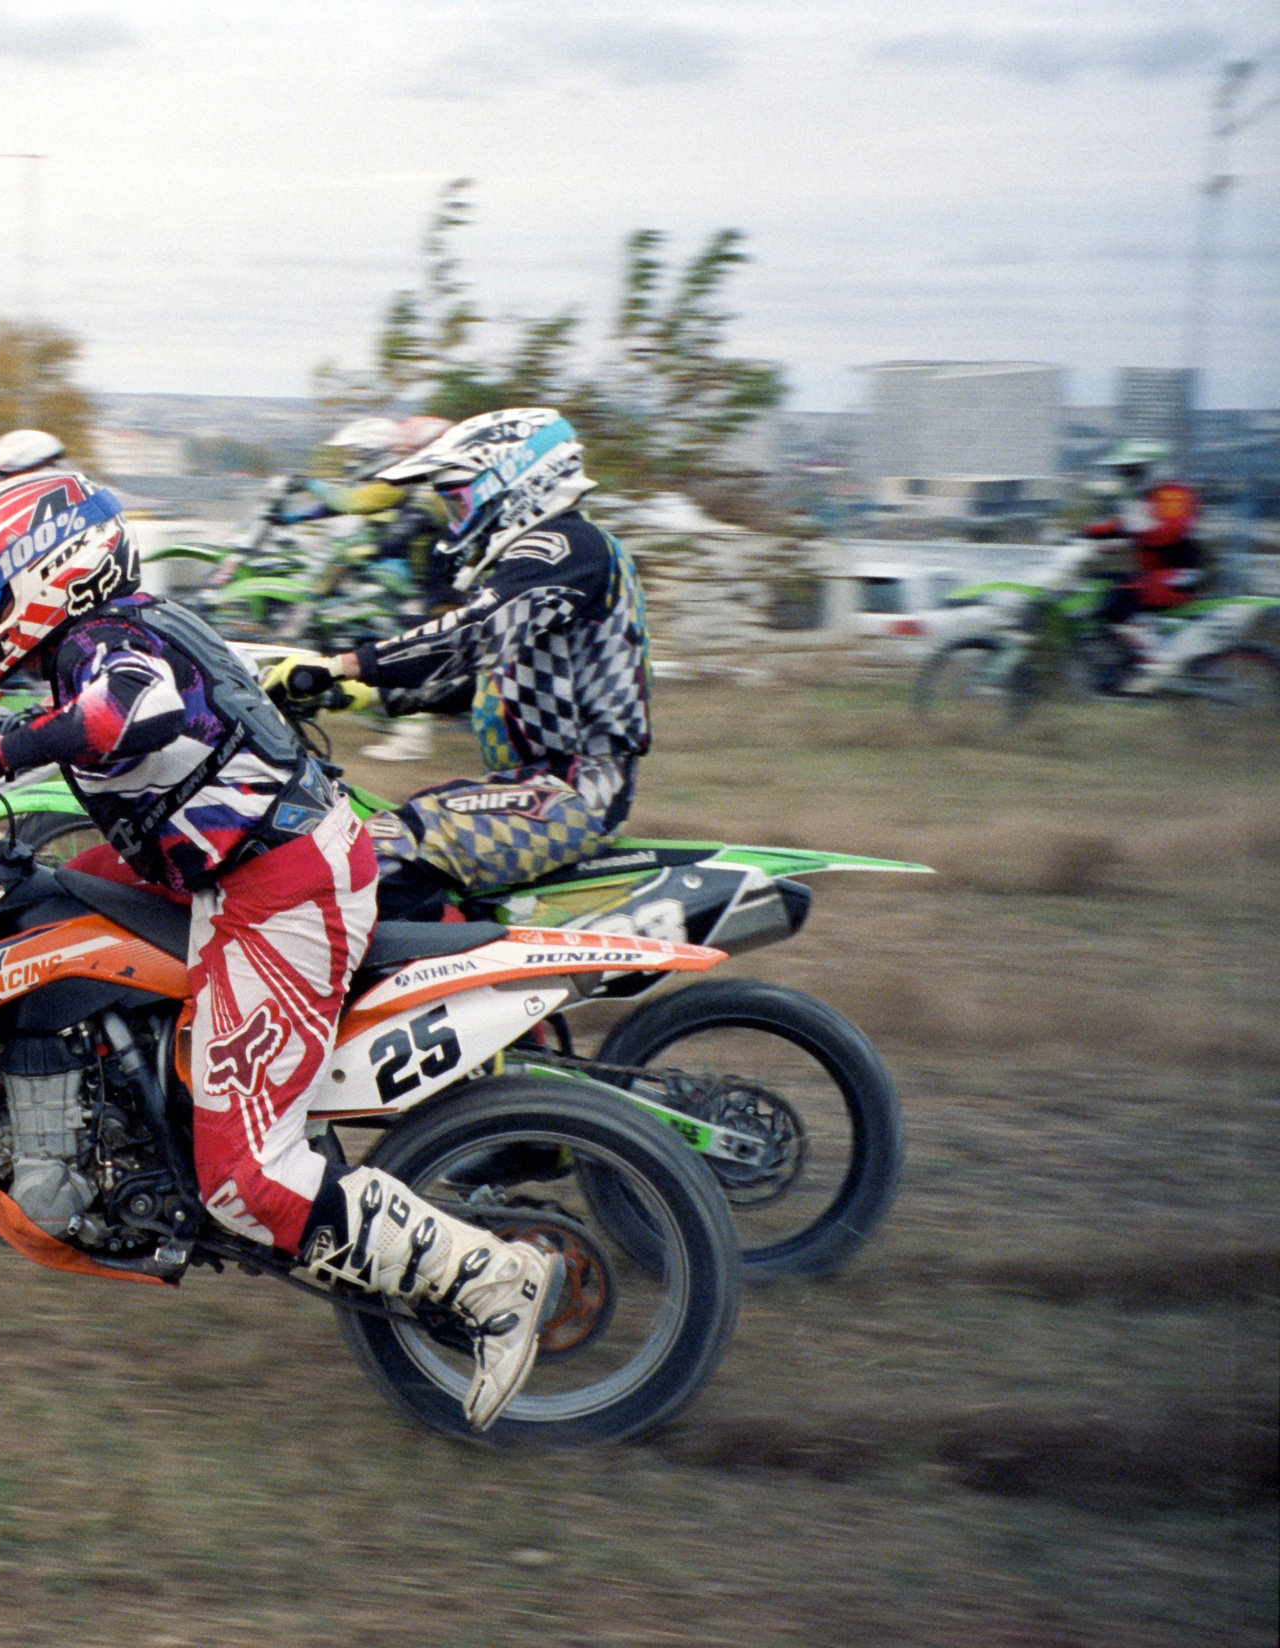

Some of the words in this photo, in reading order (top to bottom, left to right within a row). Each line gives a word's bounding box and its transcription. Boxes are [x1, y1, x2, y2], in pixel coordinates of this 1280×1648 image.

[39, 532, 91, 581] FOX
[445, 790, 535, 812] SHIFT
[523, 951, 643, 965] DUNLOP
[411, 959, 479, 984] ATHENA
[369, 1003, 462, 1106] 25
